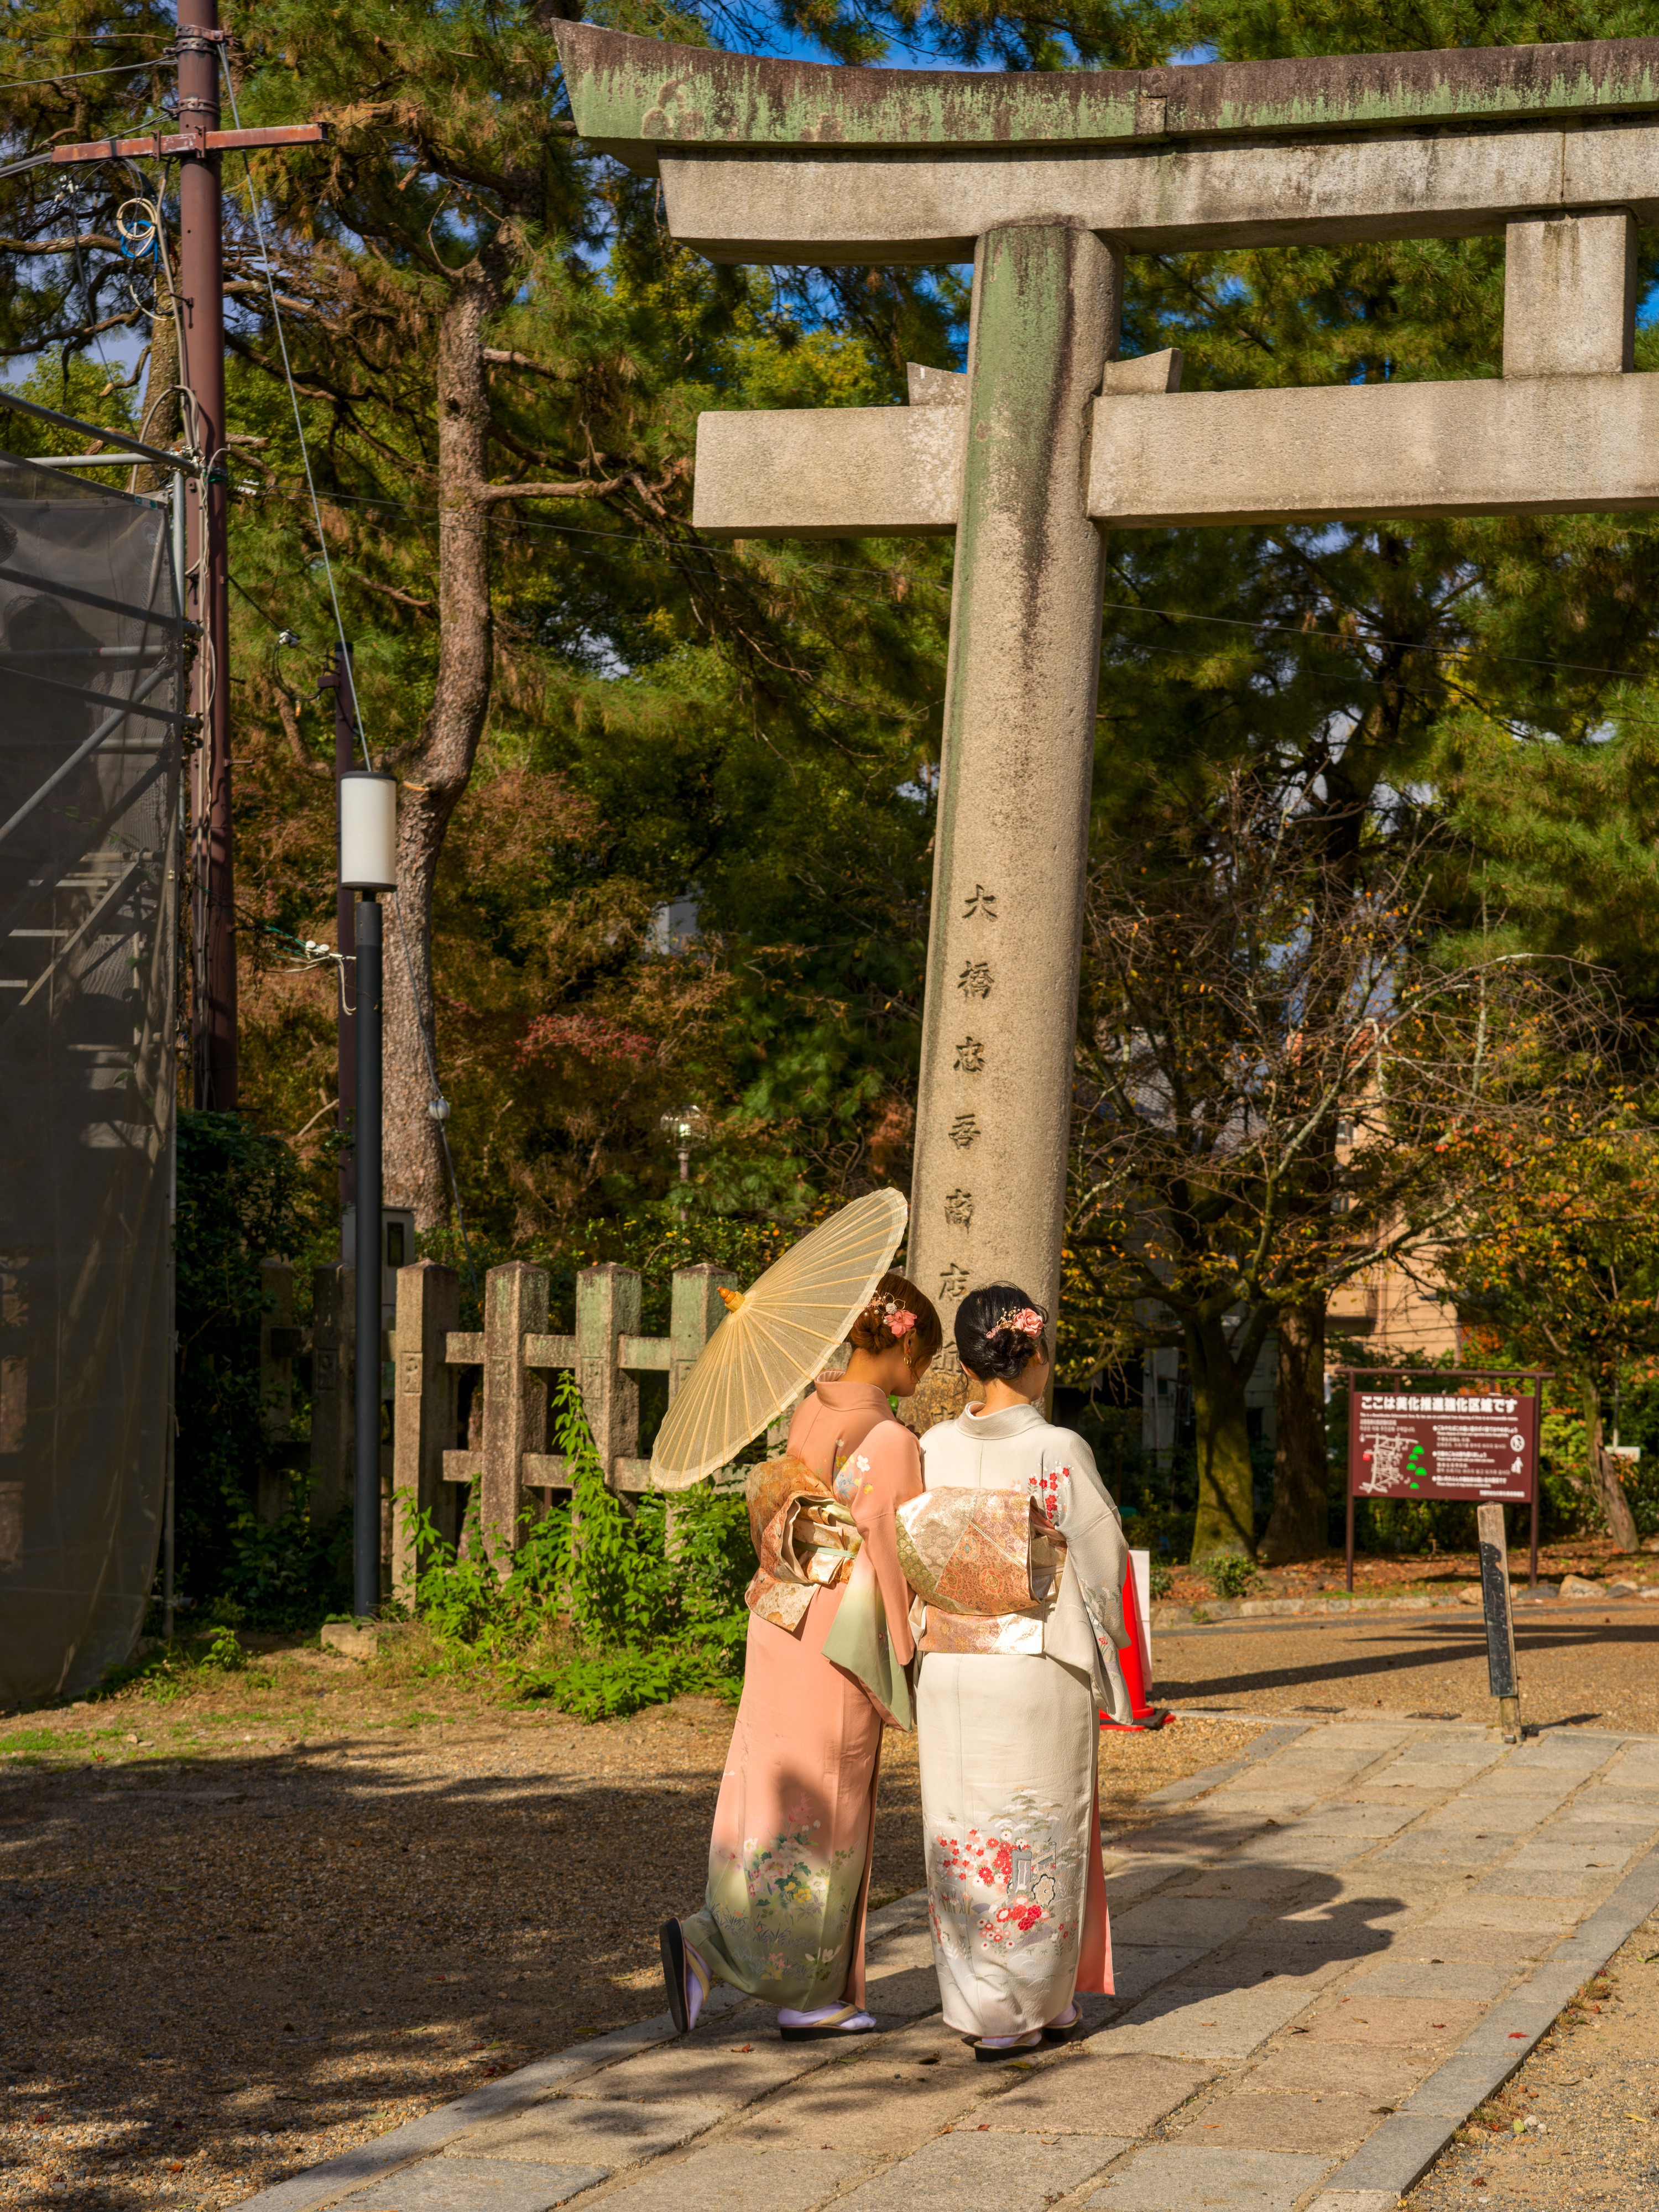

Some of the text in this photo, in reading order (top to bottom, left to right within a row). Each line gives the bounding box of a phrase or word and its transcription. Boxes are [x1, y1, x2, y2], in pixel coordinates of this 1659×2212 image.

[1361, 1396, 1518, 1413] ここは美化推進強化区域です
